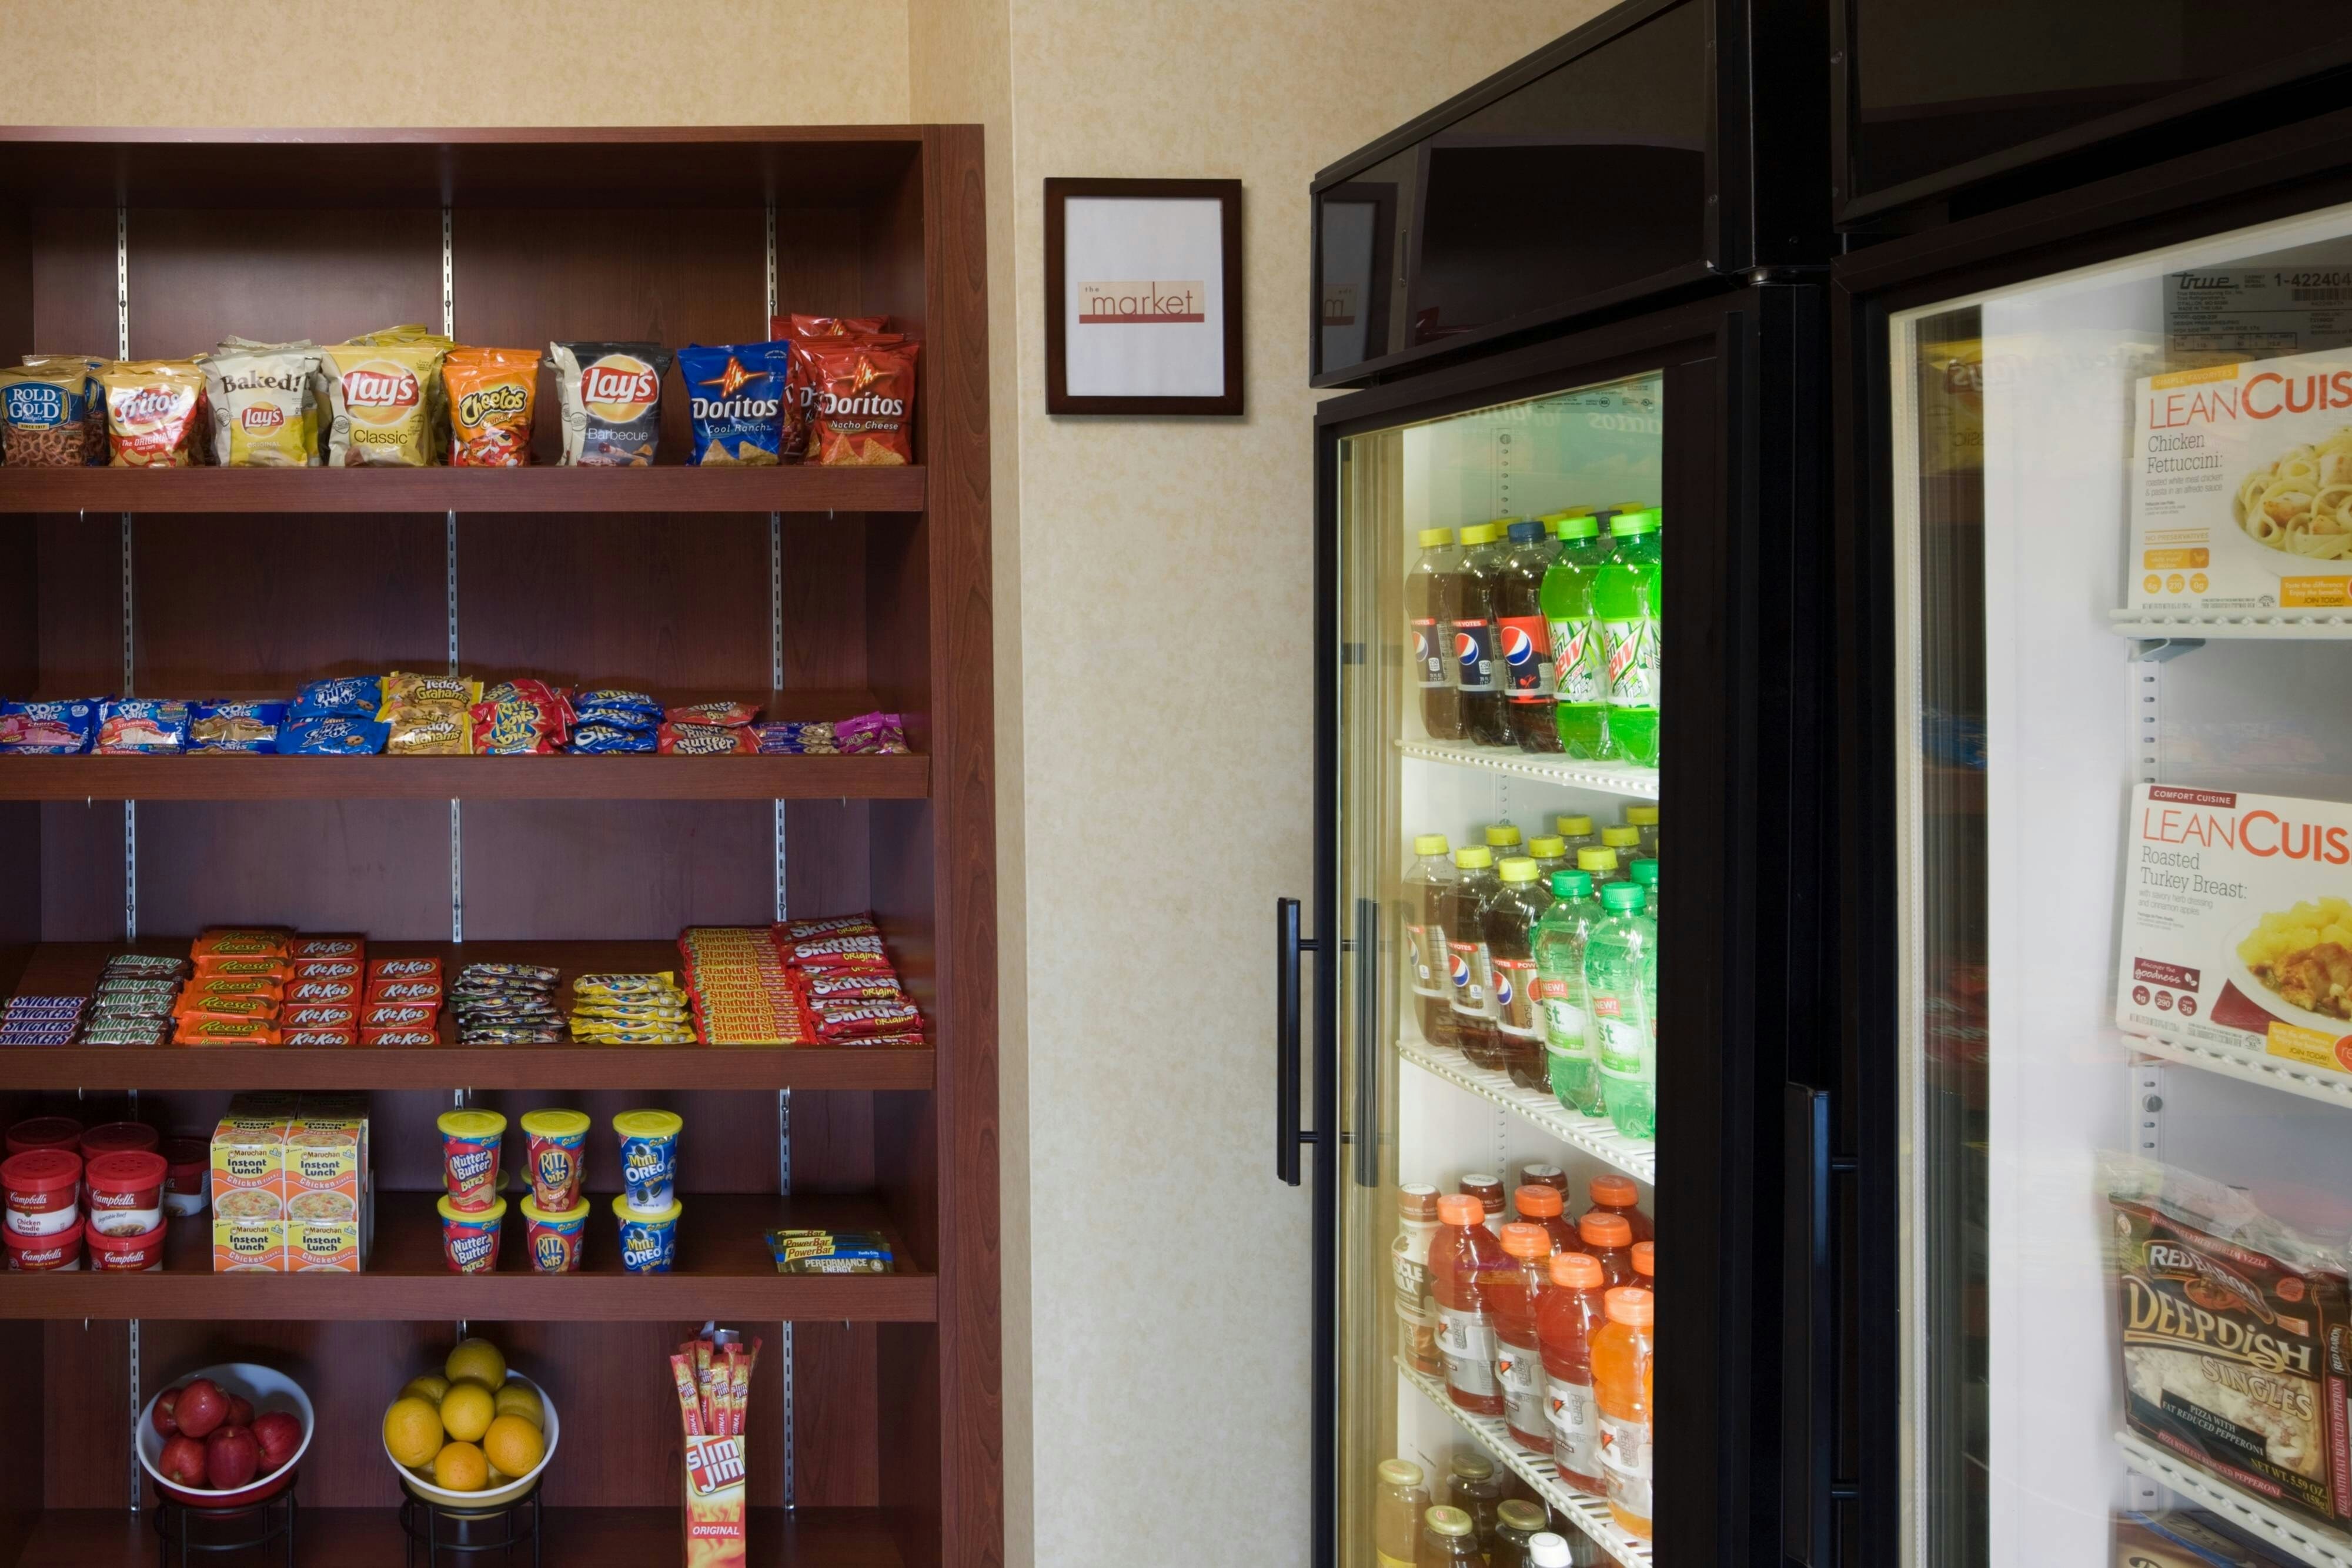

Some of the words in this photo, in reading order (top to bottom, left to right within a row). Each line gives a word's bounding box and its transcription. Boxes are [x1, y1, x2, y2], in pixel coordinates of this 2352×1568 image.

[1093, 281, 1193, 315] market
[220, 370, 299, 394] Baked!
[348, 372, 414, 406] Lay's
[586, 368, 653, 404] Lay's
[12, 389, 56, 402] ROLD
[9, 402, 59, 418] GOLD
[461, 386, 526, 425] Cheetos
[691, 395, 779, 419] Doritos
[824, 392, 903, 416] Doritos
[2150, 386, 2238, 430] LEAN
[244, 408, 280, 427] Lay's
[709, 424, 730, 433] Cool
[734, 423, 766, 433] Ranch
[830, 420, 861, 429] Nacho
[865, 420, 898, 430] Cheese
[354, 429, 408, 444] Classic
[588, 428, 648, 441] Barbecue
[2148, 433, 2204, 452] Chicken
[2169, 477, 2184, 486] white
[2201, 473, 2223, 483] chicken
[2151, 487, 2168, 498] pasta
[2206, 484, 2223, 492] sauce
[424, 679, 465, 693] Teddy
[416, 686, 469, 704] Grahams
[2154, 790, 2194, 801] COMFORT
[2197, 794, 2231, 804] CUISINE
[2144, 808, 2234, 851] LEAN
[2239, 810, 2352, 865] CUIS
[2141, 845, 2200, 870] Roasted
[2140, 867, 2190, 893] Turkey
[217, 960, 275, 970] Reese's
[2135, 968, 2181, 984] goodness
[205, 979, 264, 990] Reese's
[813, 977, 901, 995] Skittles
[1542, 982, 1565, 992] NEW!
[12, 997, 84, 1008] SNICKERS
[198, 996, 258, 1010] Reese's
[1594, 999, 1617, 1009] NEW!
[2136, 993, 2146, 1004] 4g
[2157, 997, 2171, 1008] 290
[8, 1009, 78, 1019] SNICKERS
[2181, 1002, 2193, 1014] 3g
[5, 1021, 75, 1031] SNICKERS
[199, 1020, 260, 1031] Reese's
[228, 1159, 266, 1167] Instant
[452, 1152, 487, 1169] Nutter
[541, 1152, 567, 1173] RITZ
[628, 1154, 657, 1167] Mini
[457, 1159, 490, 1180] Butter
[544, 1169, 566, 1183] bits
[626, 1164, 665, 1183] OREO
[227, 1175, 262, 1188] Chicken
[10, 1191, 47, 1205] Campbell's
[92, 1189, 135, 1206] Campbell's
[302, 1235, 342, 1244] Instant
[626, 1238, 654, 1251] Mini
[307, 1243, 338, 1252] Lunch
[788, 1245, 833, 1259] PowerBar
[105, 1251, 144, 1265] Campbell's
[302, 1252, 337, 1263] Chicken
[624, 1247, 662, 1266] OREO
[805, 1258, 868, 1268] PERFORMANCE
[2150, 1245, 2193, 1269] RED
[2201, 1355, 2313, 1422] SINGLES
[2190, 1404, 2212, 1420] PIZZA
[2213, 1415, 2236, 1432] WITH
[2162, 1401, 2177, 1415] FAT
[2177, 1407, 2215, 1433] REDUCED
[2215, 1425, 2264, 1456] PEPPERONI
[2290, 1475, 2308, 1491] 5.59
[693, 1526, 740, 1535] ORIGINAL
